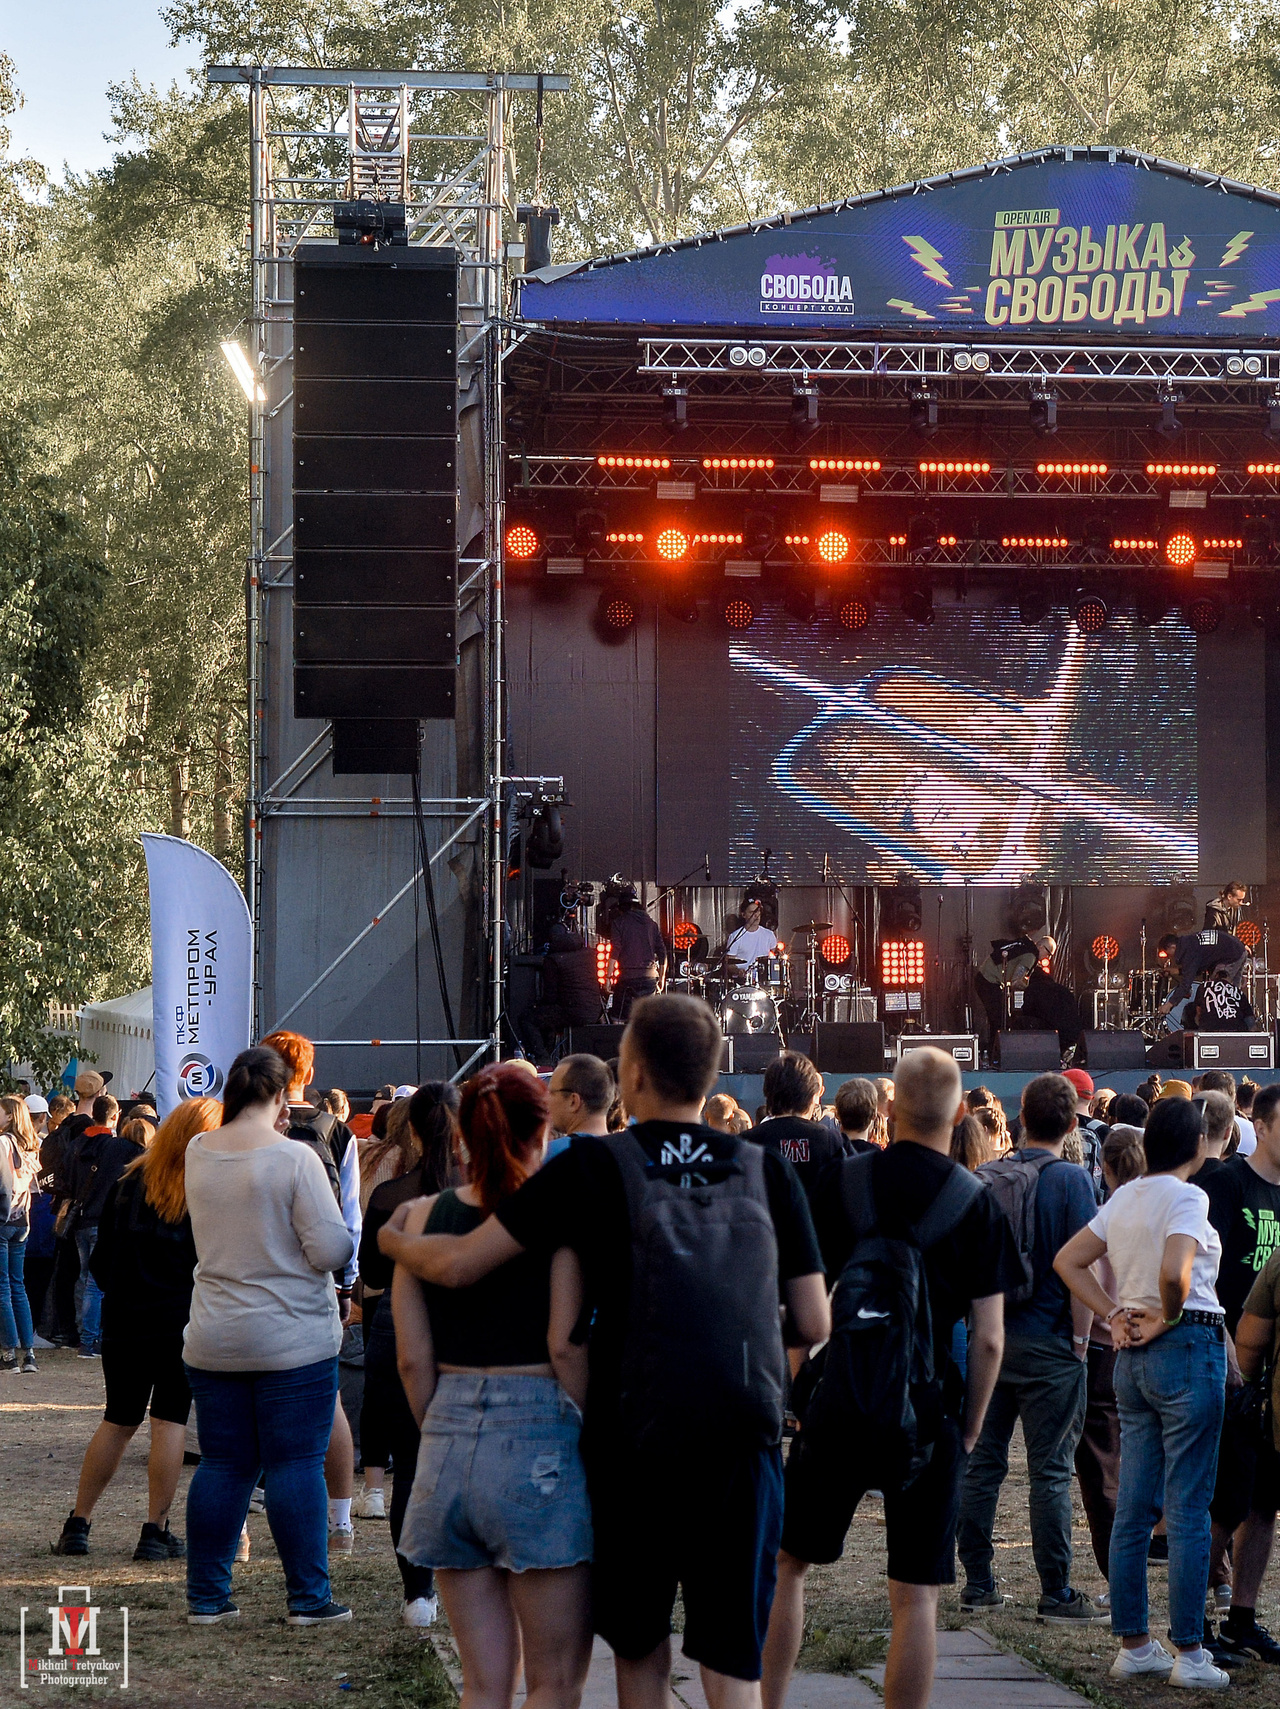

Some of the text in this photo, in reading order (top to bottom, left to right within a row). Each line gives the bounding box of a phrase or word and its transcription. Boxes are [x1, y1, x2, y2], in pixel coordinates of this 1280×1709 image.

[1003, 210, 1051, 225] OPEN AIR
[989, 222, 1168, 277] МУЗЫКА
[760, 274, 853, 303] СВОБОДА
[765, 304, 816, 312] КОНЦЕРТ
[984, 270, 1190, 326] СВОБОДЫ
[187, 929, 200, 1045] МЕТПРОМ
[176, 1005, 185, 1045] ПКФ
